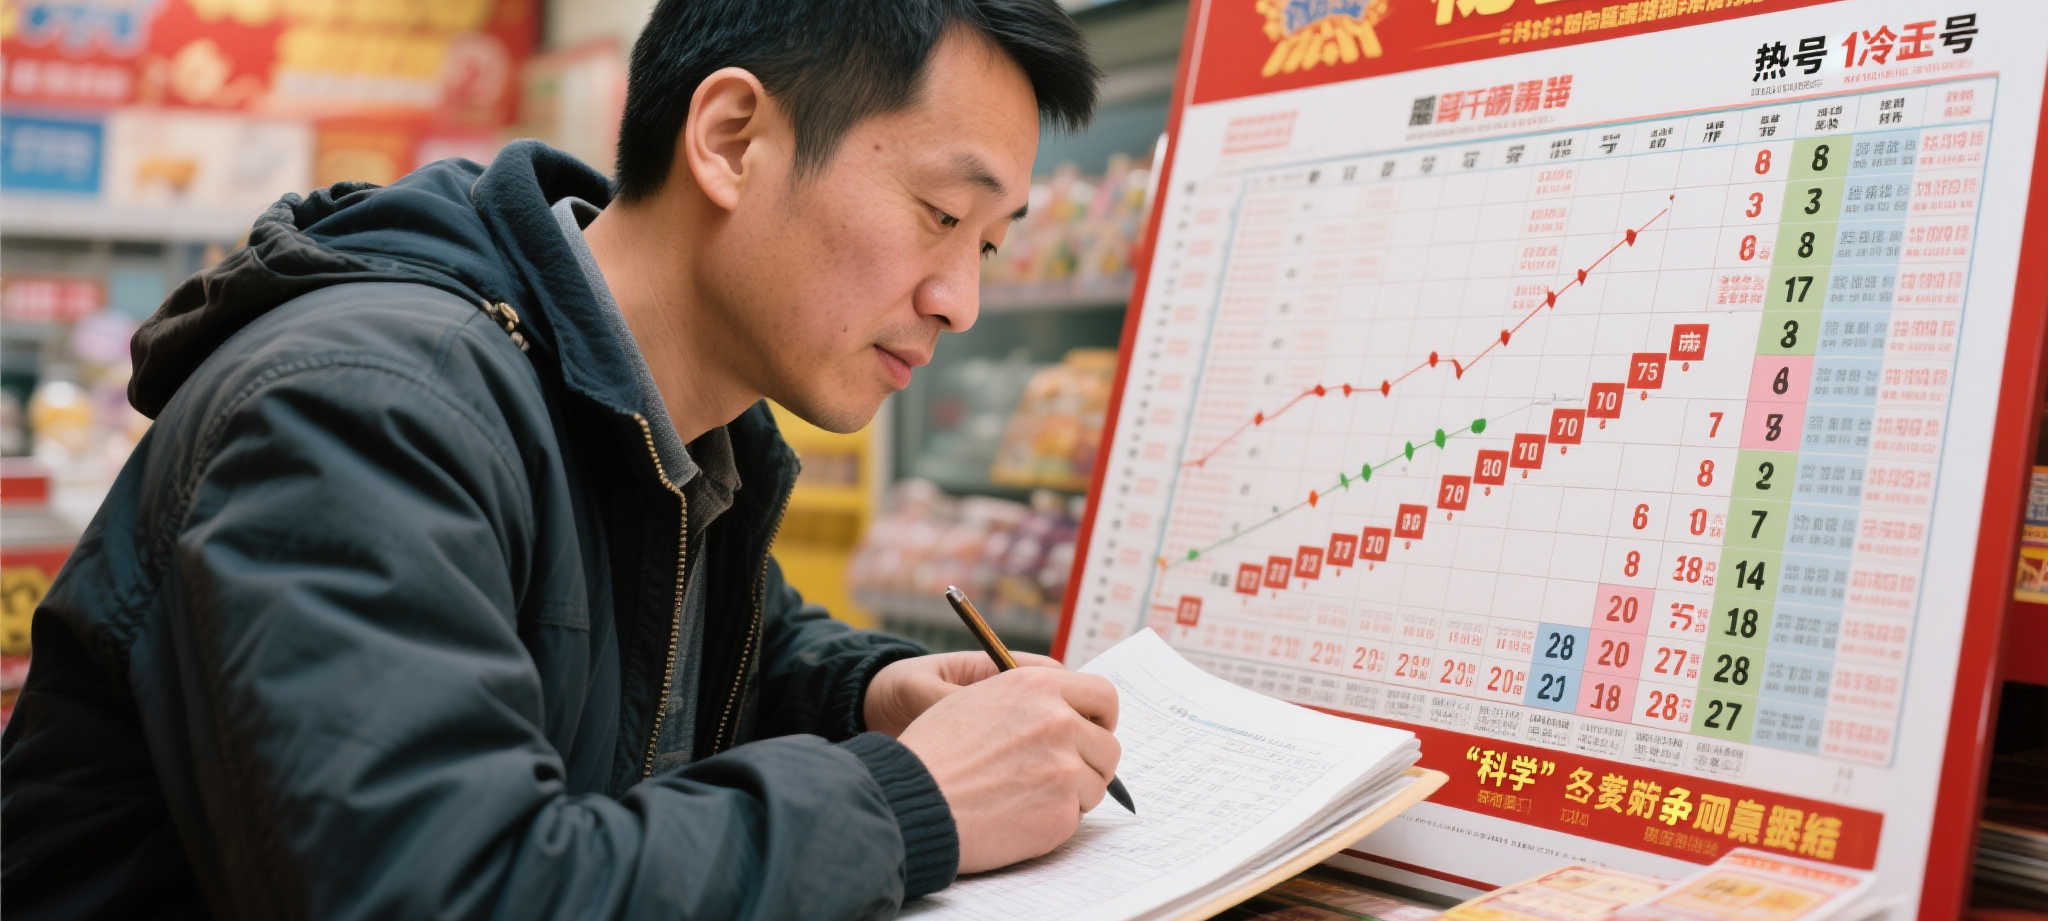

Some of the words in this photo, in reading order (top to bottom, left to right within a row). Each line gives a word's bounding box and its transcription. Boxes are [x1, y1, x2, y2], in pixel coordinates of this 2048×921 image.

[1752, 35, 1828, 82] 热号
[1754, 149, 1771, 174] 8
[1812, 144, 1829, 171] 8
[1745, 192, 1764, 218] 3
[1804, 187, 1823, 214] 3
[1797, 232, 1815, 258] 8
[1784, 276, 1813, 302] 17
[1708, 412, 1724, 438] 7
[1696, 459, 1715, 487] 8
[1755, 461, 1774, 490] 2
[1632, 503, 1650, 530] 6
[1750, 510, 1768, 538] 7
[1624, 550, 1641, 577] 8
[1735, 560, 1765, 590] 14
[1606, 595, 1639, 624] 20
[1724, 607, 1758, 639] 18
[1545, 632, 1575, 660] 28
[1598, 640, 1630, 668] 20
[1654, 647, 1687, 676] 27
[1713, 654, 1750, 686] 28
[1590, 682, 1622, 712] 18
[1646, 690, 1679, 721] 28
[1704, 700, 1743, 731] 27
